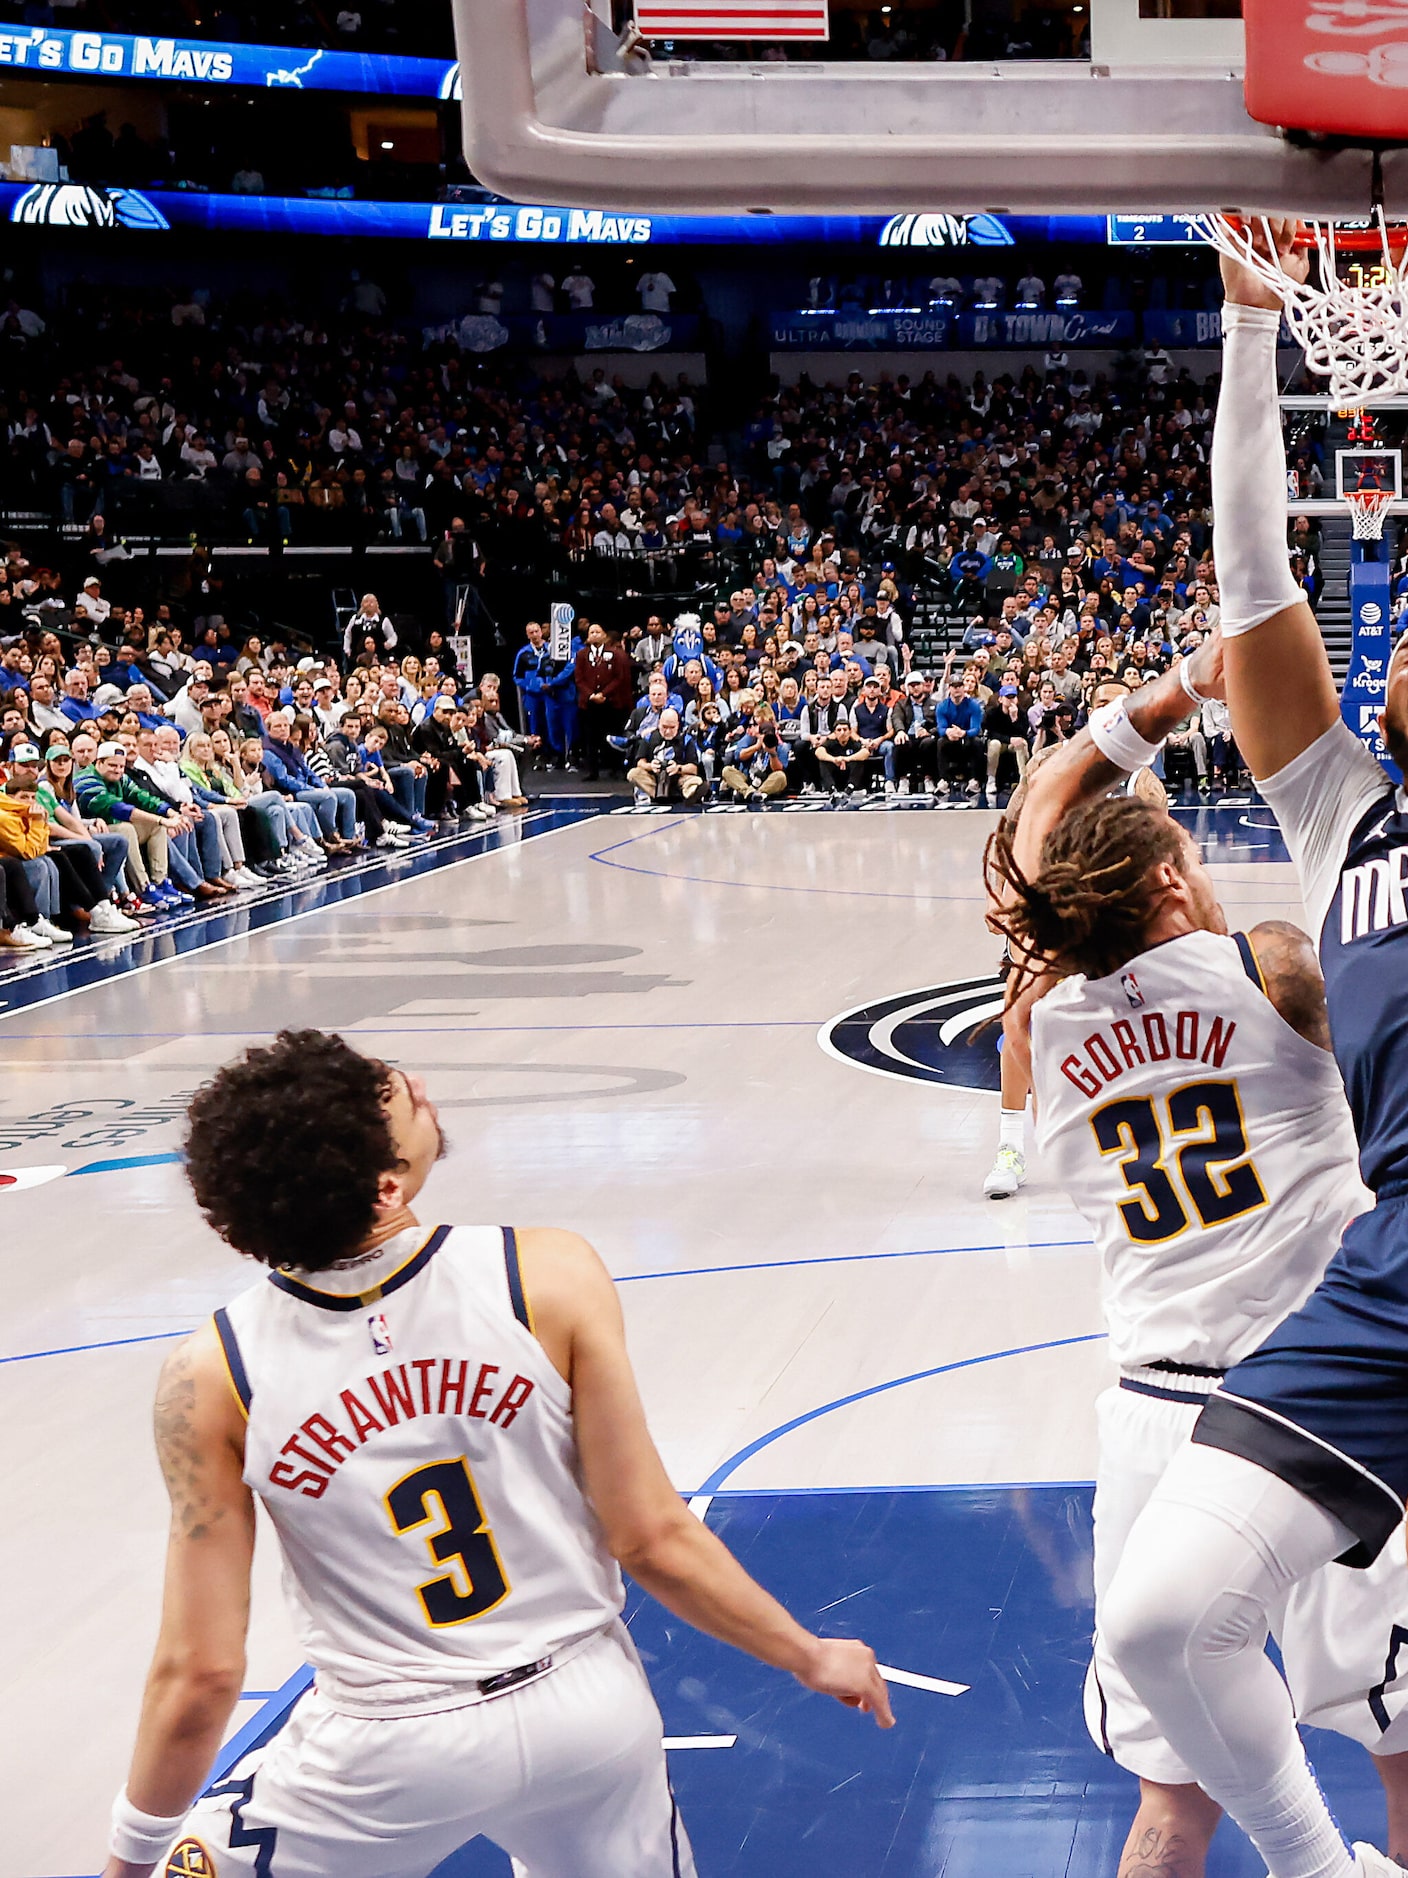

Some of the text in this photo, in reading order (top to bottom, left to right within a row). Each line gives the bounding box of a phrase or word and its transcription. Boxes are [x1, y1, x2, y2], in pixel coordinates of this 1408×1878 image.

[1133, 226, 1193, 240] 2 1
[775, 330, 830, 344] ULTRA
[894, 319, 945, 332] SOUND
[896, 330, 944, 344] STAGE
[558, 624, 570, 660] AT&T
[1358, 626, 1385, 638] AT&T
[1352, 671, 1388, 695] Kroge
[1060, 1010, 1238, 1099] GORDON
[1090, 1078, 1270, 1245] 32
[269, 1358, 535, 1500] STRAWTHER
[383, 1455, 512, 1629] 3
